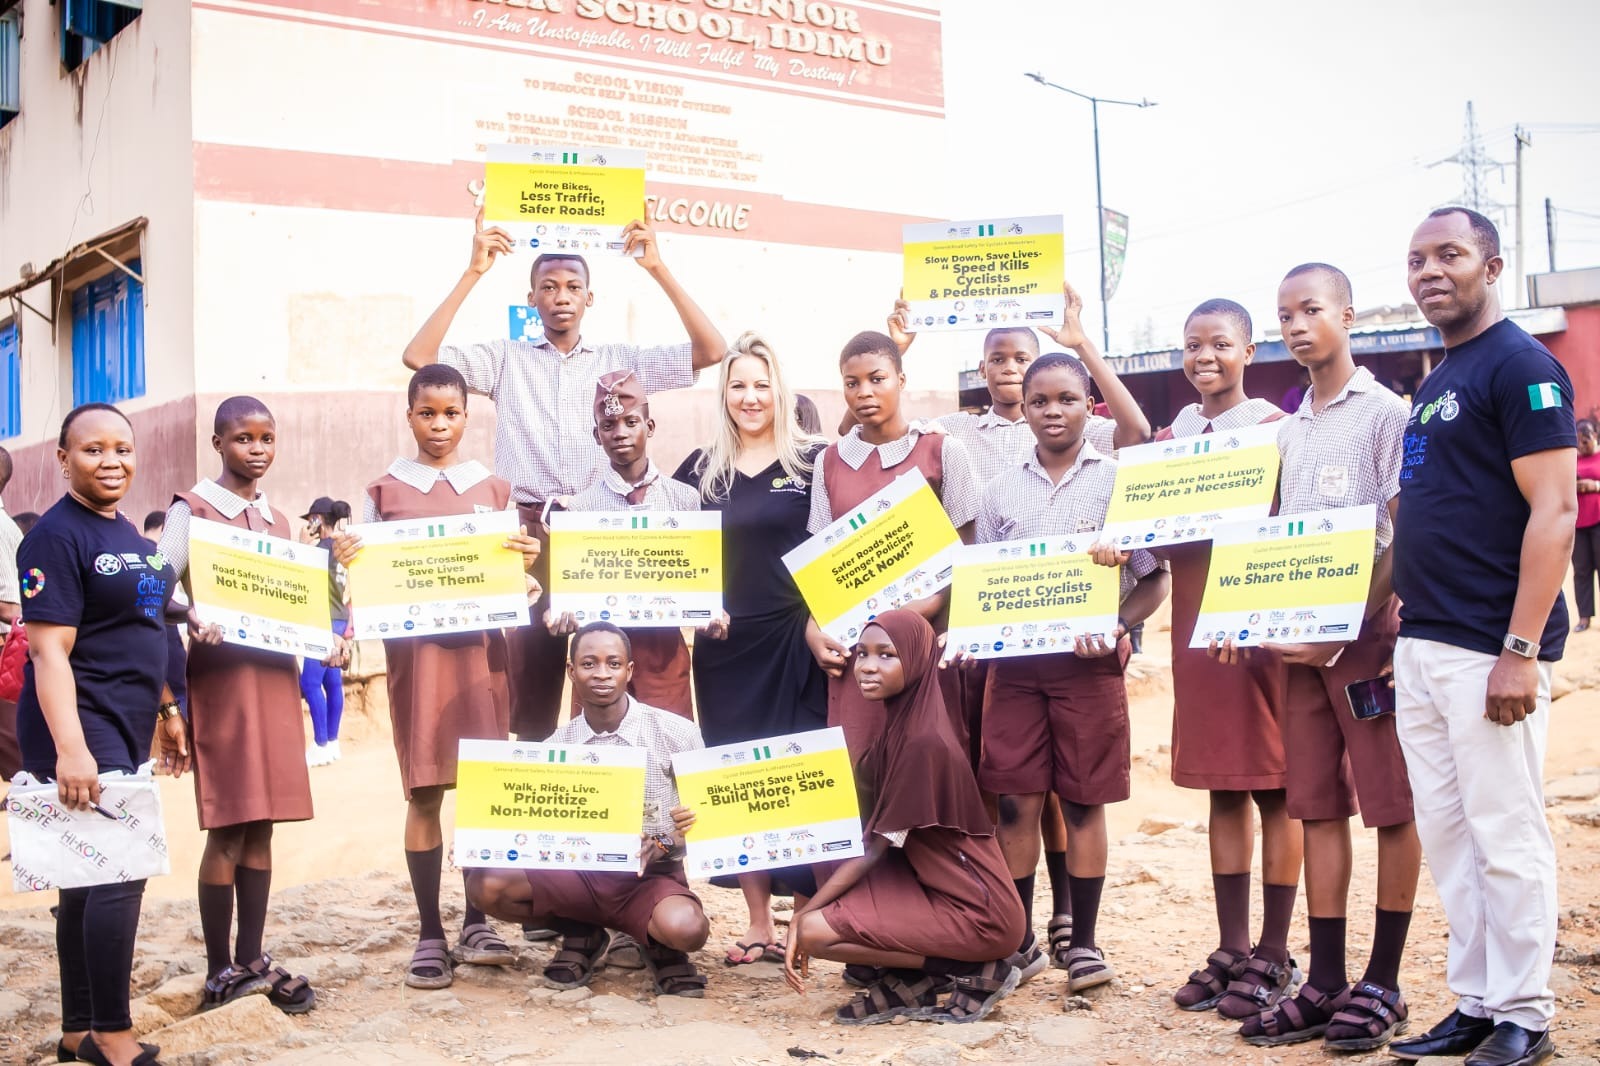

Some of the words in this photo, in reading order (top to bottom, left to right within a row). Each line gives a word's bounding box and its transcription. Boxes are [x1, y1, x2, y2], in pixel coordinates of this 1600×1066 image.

[487, 13, 522, 34] Am
[639, 34, 651, 52] I
[653, 37, 691, 58] Will
[695, 42, 746, 70] Fulfil
[752, 54, 780, 78] My
[768, 22, 894, 66] IDIMU
[523, 78, 540, 89] TO
[574, 71, 631, 90] SCHOOL
[634, 79, 685, 97] VISION
[567, 104, 625, 123] SCHOOL
[629, 112, 688, 131] MISSION
[534, 182, 559, 190] More
[562, 182, 592, 192] Bikes,
[521, 191, 551, 201] Less
[555, 192, 605, 205] Traffic,
[519, 204, 555, 215] Safer
[560, 205, 605, 217] Roads!
[924, 255, 949, 264] Slow
[951, 254, 984, 263] Down,
[986, 252, 1010, 261] Save
[953, 261, 996, 276] Speed
[1000, 260, 1030, 271] Kills
[956, 273, 1011, 287] Cyclists
[929, 288, 939, 299] &
[1124, 491, 1155, 503] They
[1158, 487, 1181, 499] Are
[1184, 487, 1192, 496] a
[1195, 475, 1264, 494] Necessity!
[1125, 478, 1175, 493] Sidewalks
[1178, 476, 1195, 485] Are
[1197, 473, 1215, 482] Not
[587, 549, 617, 558] Every
[620, 548, 640, 557] Life
[643, 549, 684, 557] Counts:
[831, 557, 855, 577] Safer
[856, 538, 885, 560] Roads
[884, 521, 910, 541] Need
[391, 558, 423, 568] Zebra
[426, 553, 479, 565] Crossings
[593, 557, 633, 568] Make
[637, 557, 690, 568] Streets
[1246, 559, 1287, 572] Respect
[1289, 555, 1333, 568] Cyclists:
[212, 564, 235, 576] Road
[237, 569, 265, 585] Safety
[267, 575, 275, 585] is
[408, 568, 434, 577] Save
[437, 564, 465, 575] Lives
[562, 568, 593, 580] Safe
[598, 568, 620, 580] for
[624, 568, 697, 581] Everyone!
[835, 556, 875, 585] Stronger
[987, 577, 1010, 586] Safe
[1012, 573, 1045, 584] Roads
[1047, 571, 1063, 580] for
[1065, 568, 1083, 578] All:
[1219, 575, 1241, 588] We
[1244, 571, 1285, 586] Share
[1288, 568, 1313, 581] the
[1317, 563, 1360, 578] Road!
[406, 578, 434, 590] Use
[437, 572, 485, 587] Them!
[216, 575, 238, 589] Not
[241, 582, 248, 591] a
[252, 583, 308, 605] Privilege!
[978, 587, 1031, 602] Protect
[1035, 581, 1093, 597] Cyclists
[982, 602, 992, 612] &
[996, 592, 1088, 611] Pedestrians!
[503, 782, 536, 792] Walk.
[540, 783, 569, 793] Ride.
[572, 784, 599, 794] Live.
[707, 784, 731, 796] Bike
[733, 779, 764, 792] Lanes
[767, 774, 793, 786] Save
[796, 769, 825, 781] Lives
[513, 792, 588, 806] Prioritize
[711, 791, 749, 806] Build
[753, 784, 796, 799] More,
[799, 778, 835, 793] Save
[490, 805, 609, 820] Non-Motorized
[748, 796, 791, 813] More!
[61, 830, 108, 868] HI-KOTE
